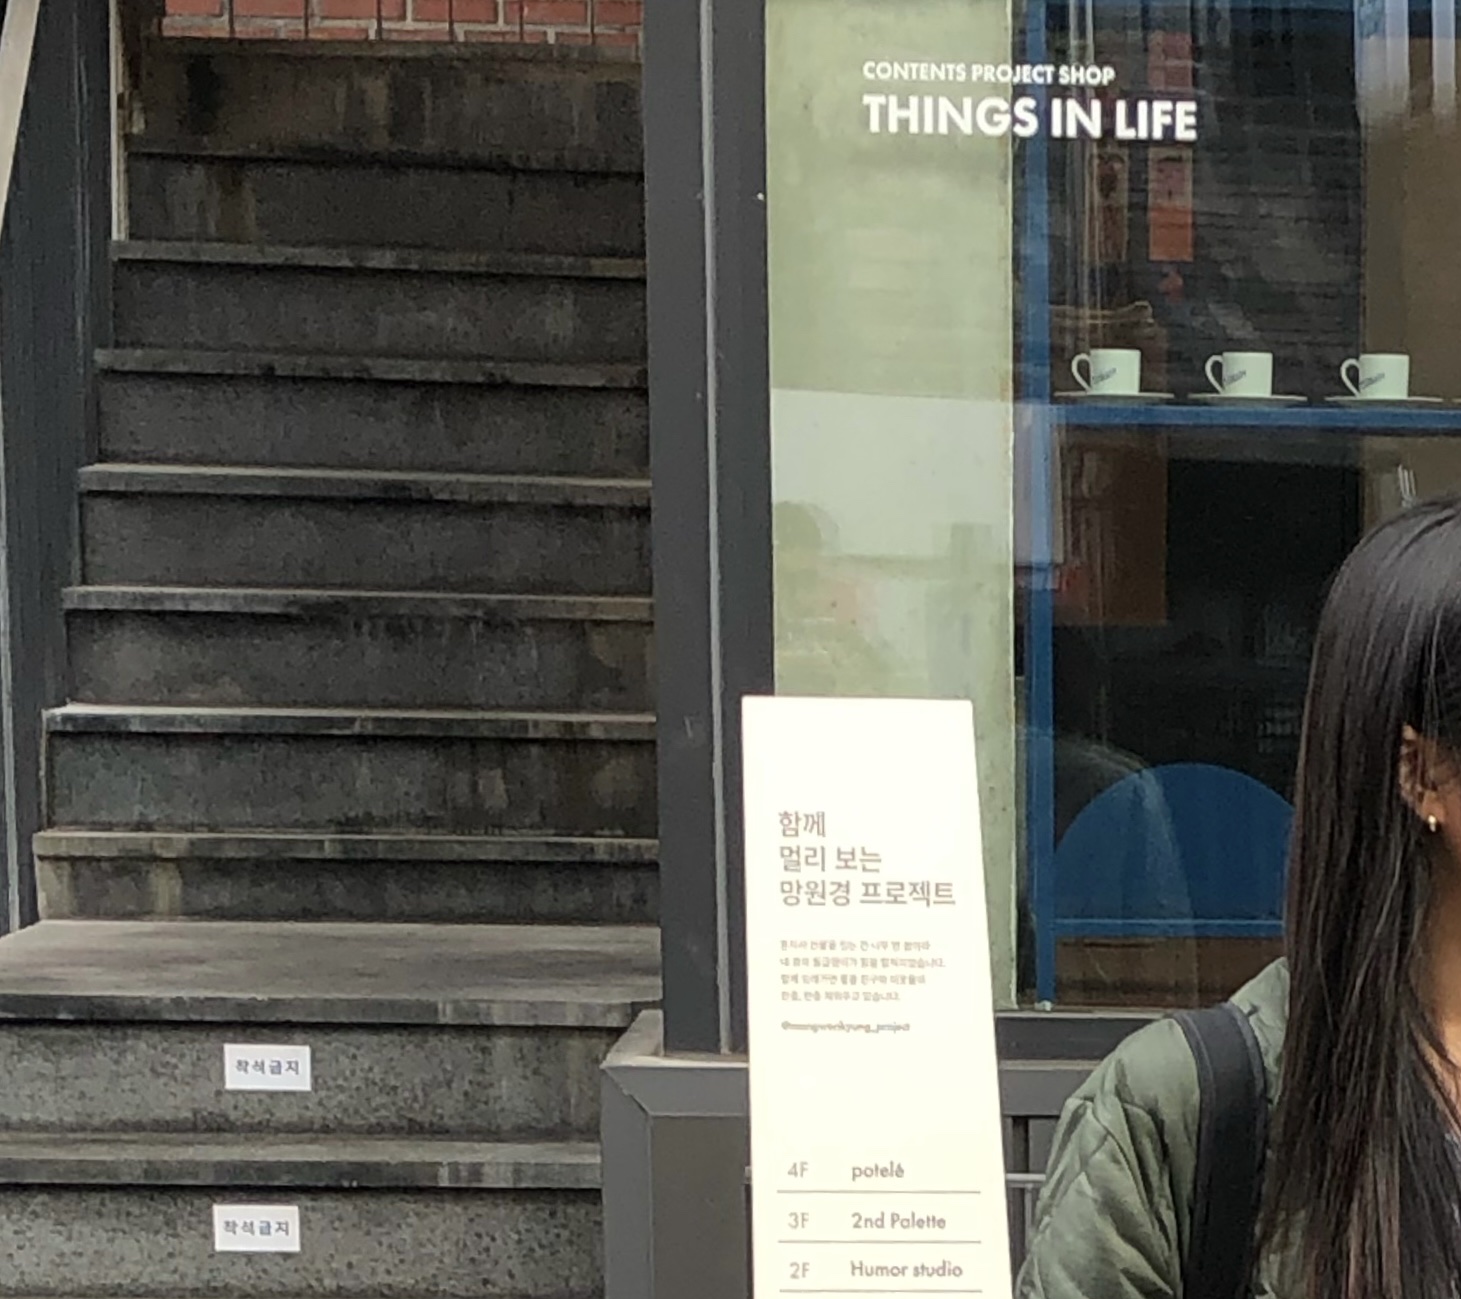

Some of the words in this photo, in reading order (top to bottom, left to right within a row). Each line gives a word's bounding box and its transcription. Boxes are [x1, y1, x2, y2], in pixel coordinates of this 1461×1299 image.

[863, 61, 966, 82] CONTENTS
[972, 63, 1054, 84] PROJECT
[1059, 65, 1115, 86] SHOP
[862, 95, 1038, 137] THINGS
[1051, 98, 1100, 139] IN
[1115, 100, 1197, 141] LIFE
[778, 811, 827, 838] 함께
[779, 846, 827, 873] 멀리
[835, 847, 882, 873] 보는
[780, 880, 851, 908] 망원경
[859, 881, 956, 908] 프로젝트
[235, 1059, 299, 1075] 착석금지
[787, 1161, 809, 1179] 4F
[223, 1220, 290, 1237] 착석금지
[788, 1212, 810, 1230] 3F
[852, 1211, 885, 1229] 2nd
[890, 1211, 947, 1230] Palette
[789, 1262, 810, 1280] 2F
[850, 1260, 908, 1278] Humor
[913, 1259, 963, 1278] studio
